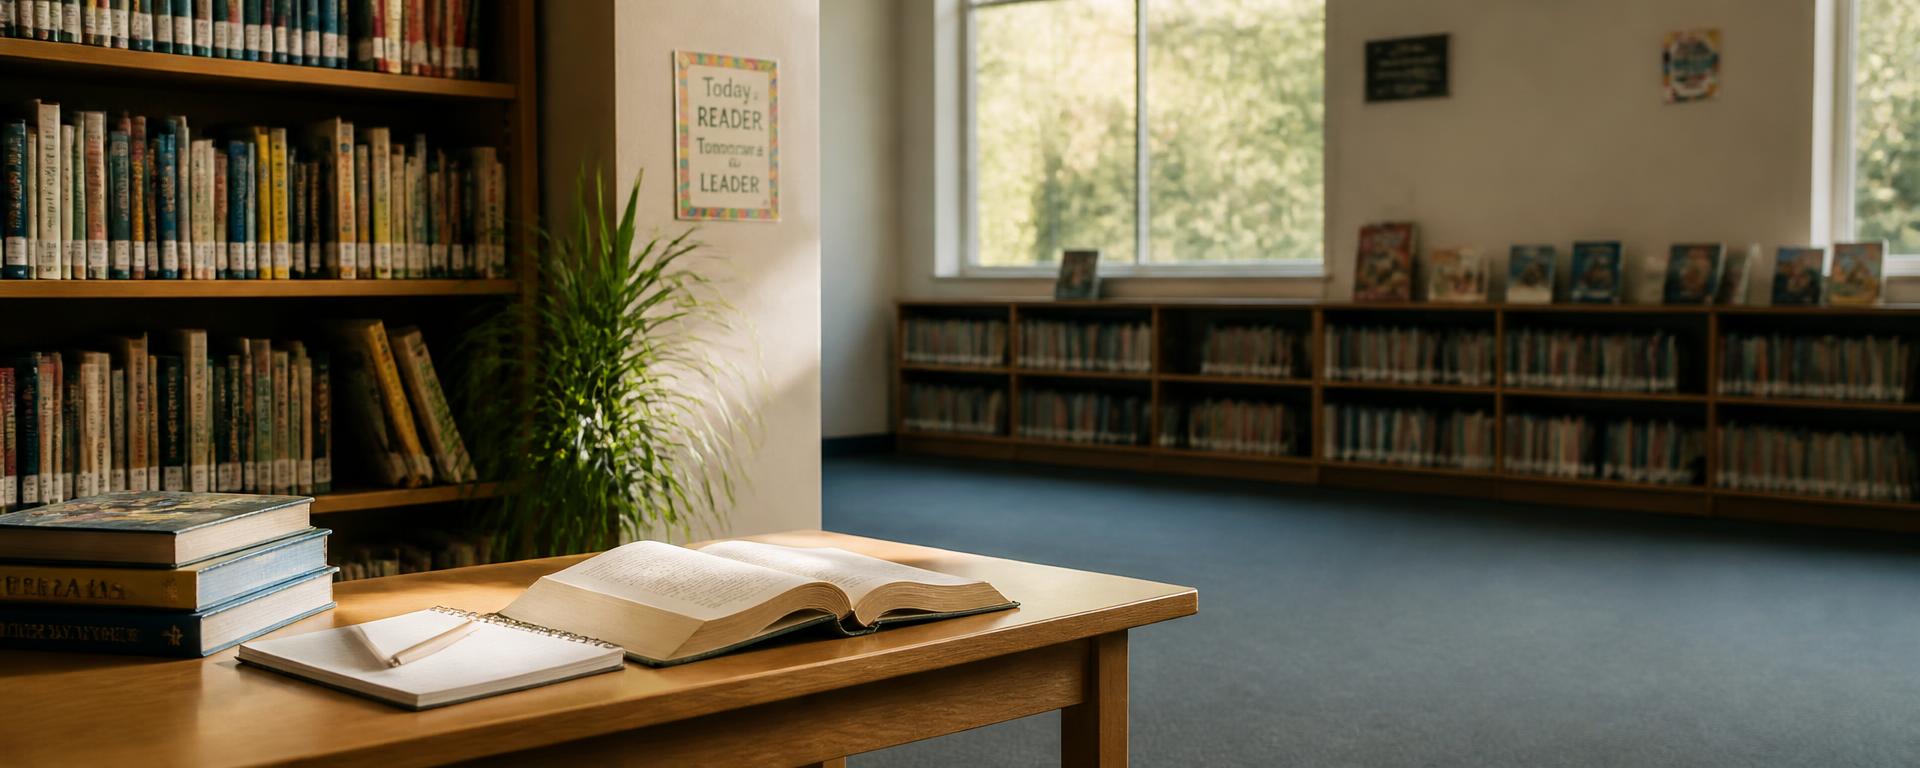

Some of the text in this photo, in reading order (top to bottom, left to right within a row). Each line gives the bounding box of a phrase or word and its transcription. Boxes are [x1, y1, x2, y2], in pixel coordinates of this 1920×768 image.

[702, 76, 751, 105] Today
[698, 106, 763, 130] READER
[701, 172, 760, 193] LEADER
